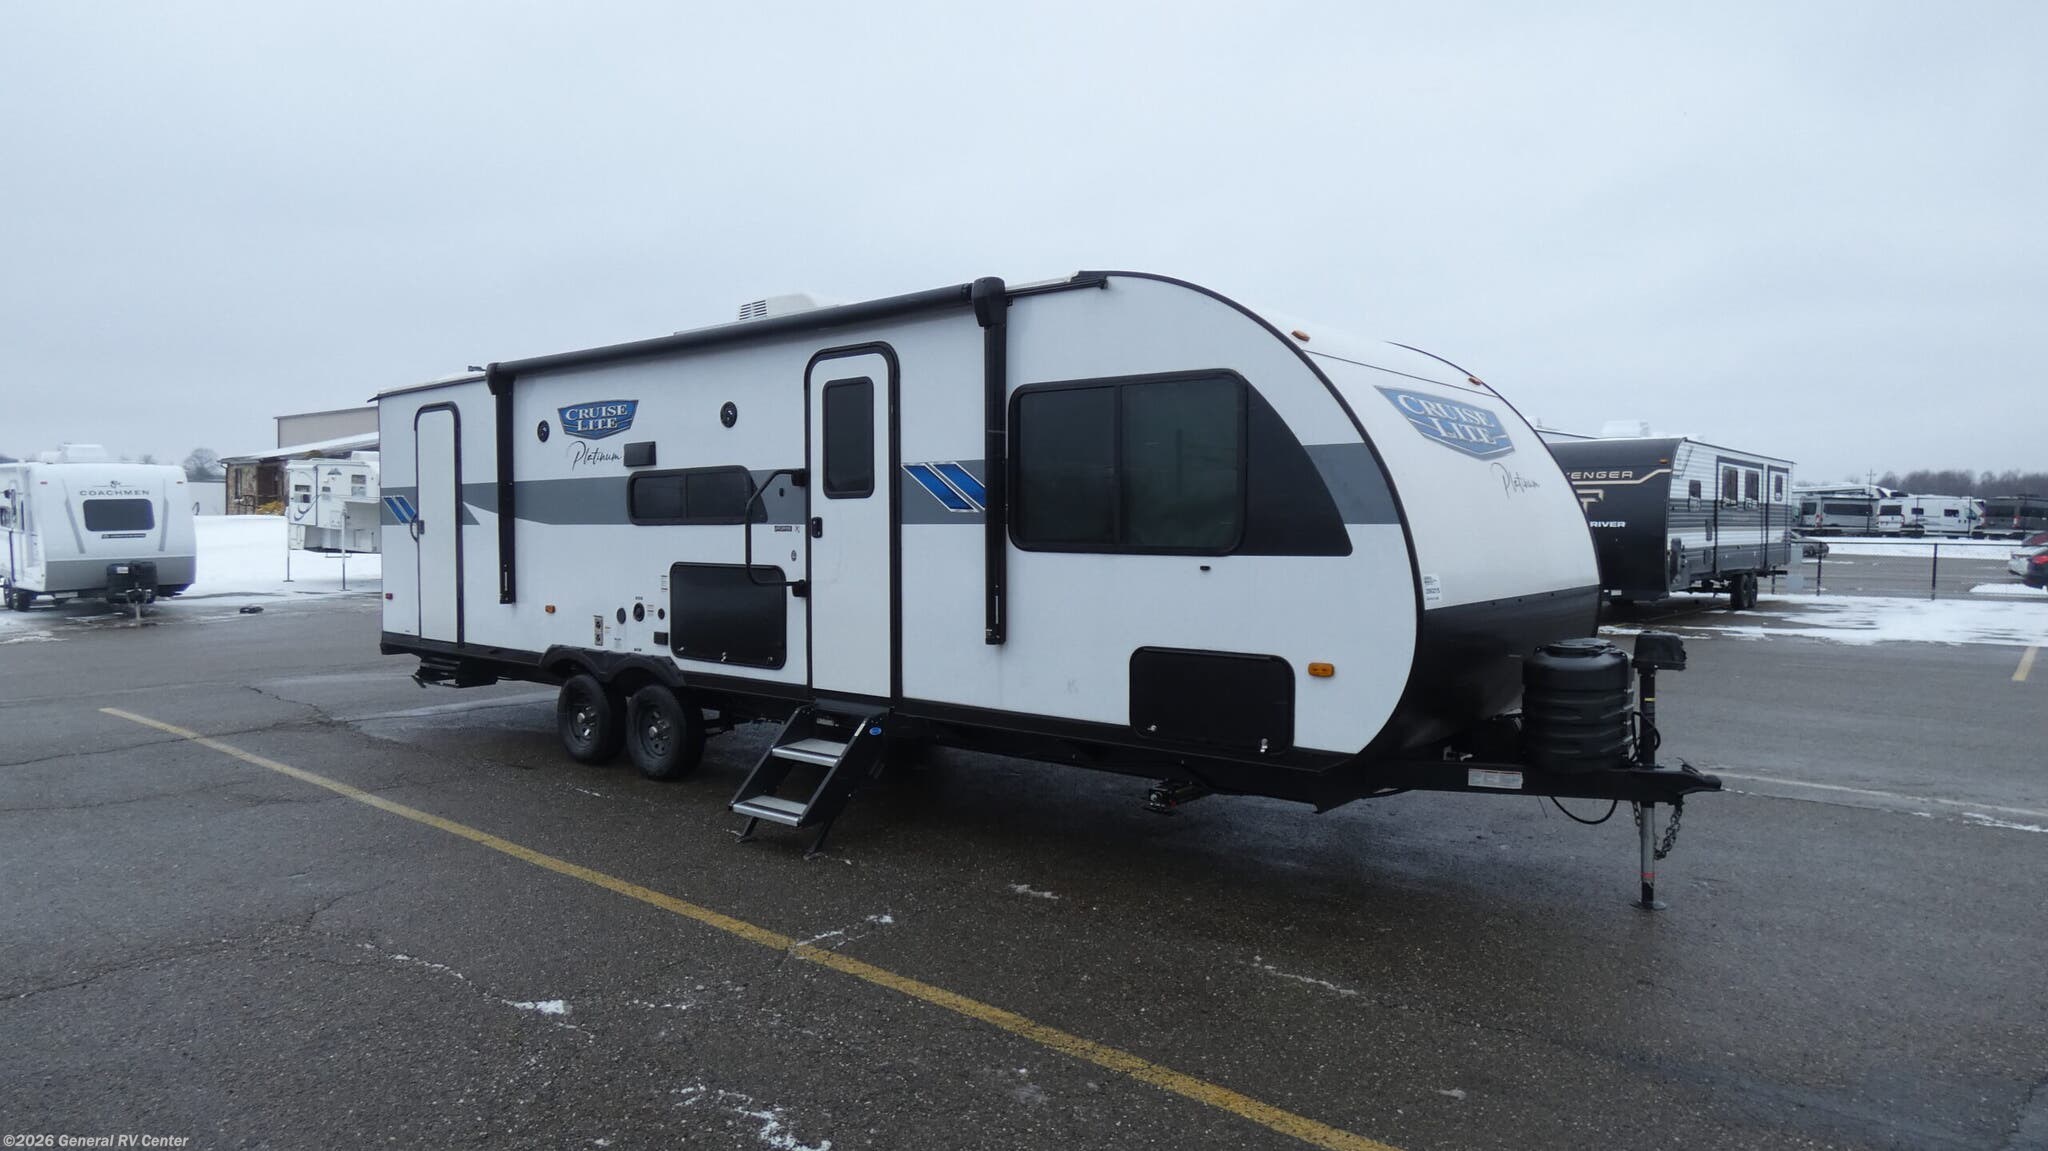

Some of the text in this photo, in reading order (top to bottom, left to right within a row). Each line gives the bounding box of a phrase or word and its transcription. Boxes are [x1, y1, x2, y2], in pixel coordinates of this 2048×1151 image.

[565, 404, 628, 421] CRUISE
[1397, 395, 1496, 428] CRUISE
[577, 417, 618, 431] LITE
[1430, 418, 1497, 445] LITE
[568, 441, 622, 471] Platinum
[1567, 471, 1633, 479] ENGER
[79, 489, 150, 497] COACHMEN
